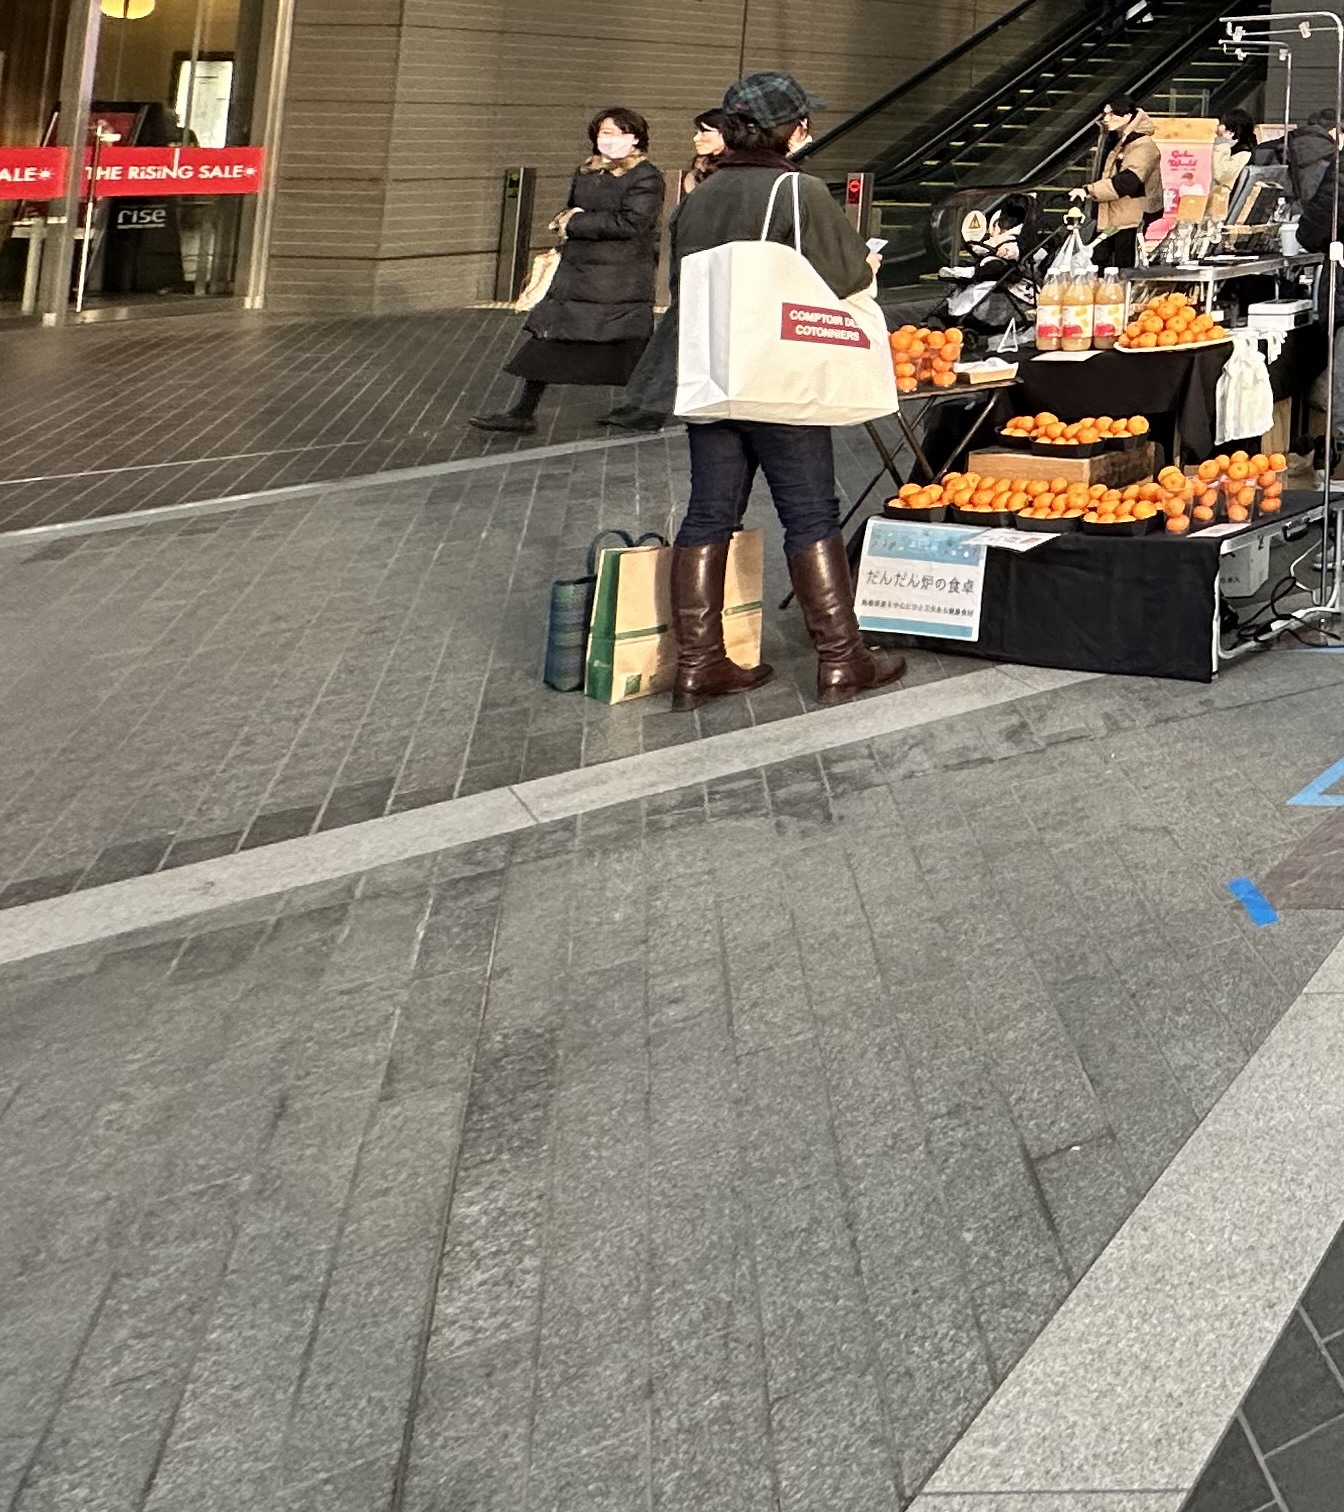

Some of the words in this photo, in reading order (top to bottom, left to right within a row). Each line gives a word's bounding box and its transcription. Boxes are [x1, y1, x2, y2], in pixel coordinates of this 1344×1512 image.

[0, 168, 37, 181] ALE
[84, 166, 123, 180] THE
[198, 165, 244, 178] SALE
[117, 208, 167, 224] rise
[789, 310, 843, 326] COMPTOIR
[866, 569, 975, 595] だんだん炉の食卓
